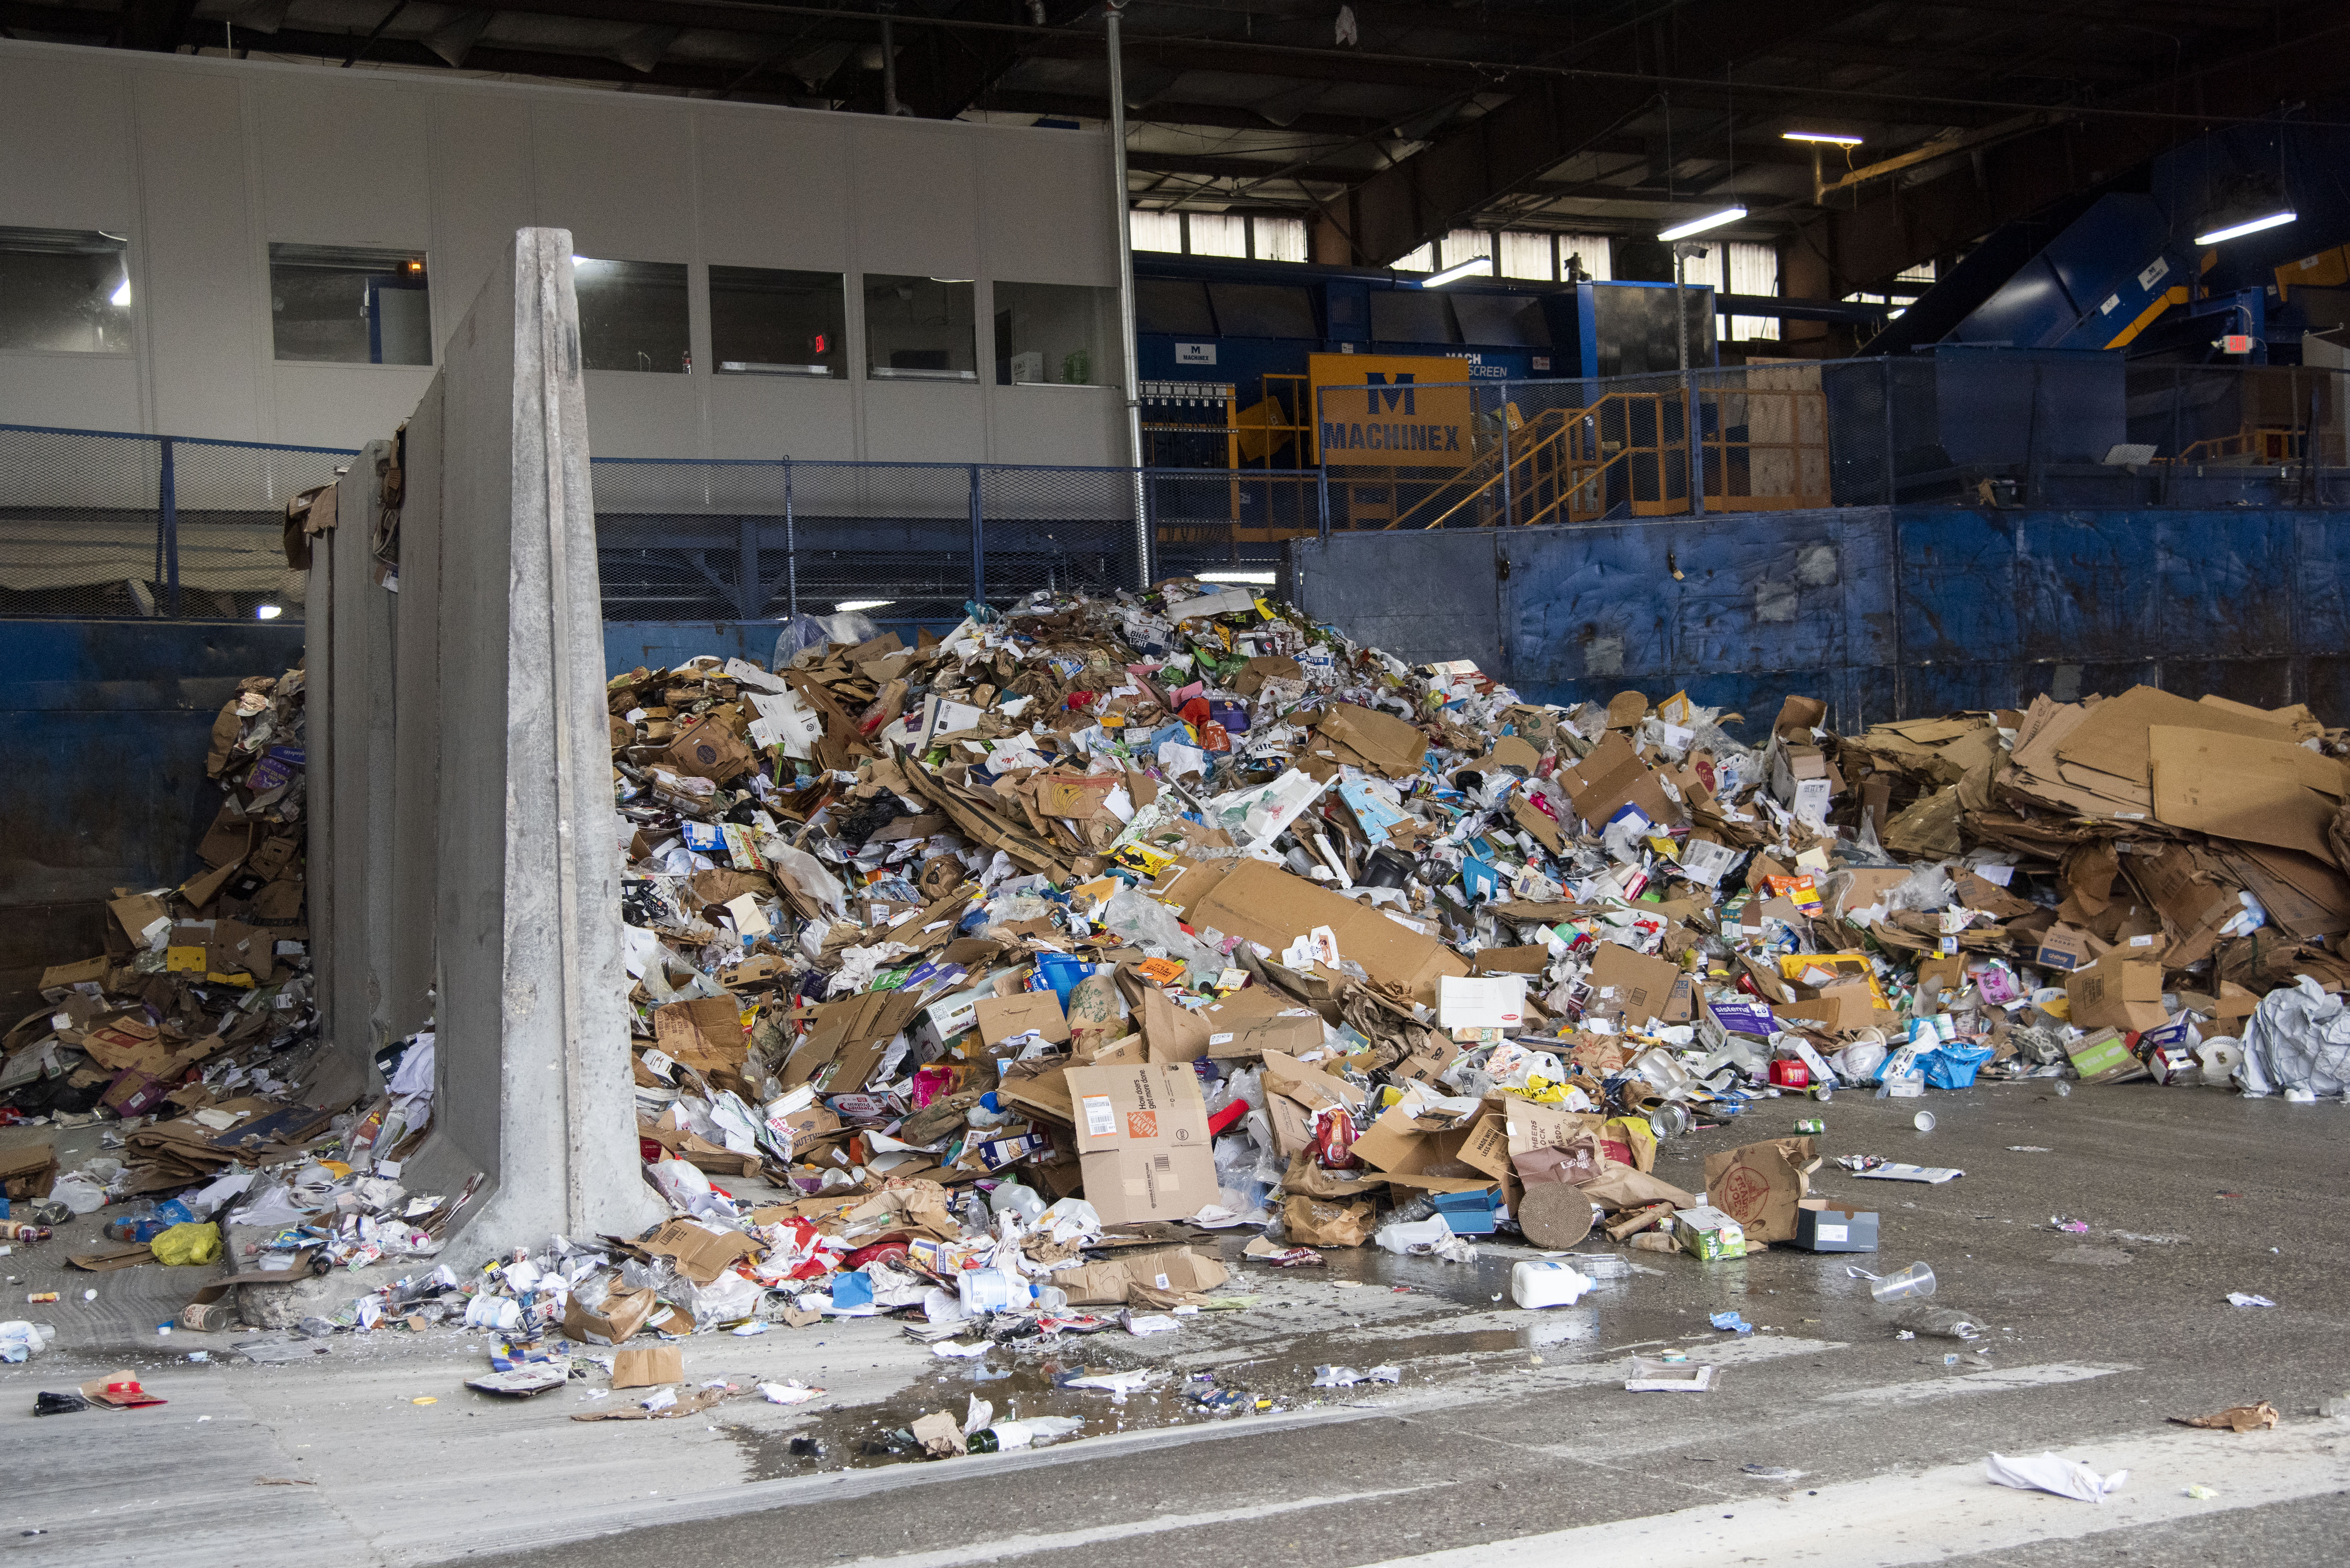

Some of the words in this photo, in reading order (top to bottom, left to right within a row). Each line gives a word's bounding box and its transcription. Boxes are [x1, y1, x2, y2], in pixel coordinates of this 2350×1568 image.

[2230, 336, 2246, 351] EXIT
[1323, 422, 1460, 451] MACHINEX
[1129, 638, 1148, 648] LIGHT
[1367, 803, 1394, 821] ALMOND
[741, 831, 765, 870] HUGGIES
[1145, 966, 1169, 978] MACHINE
[1029, 977, 1040, 993] lassic
[1715, 1006, 1749, 1014] sistema
[1141, 1069, 1149, 1084] done.
[1134, 1079, 1143, 1098] doers
[1128, 1111, 1157, 1137] HOME
[1132, 1125, 1144, 1135] THE
[1476, 1137, 1488, 1151] MADE
[1481, 1145, 1491, 1157] LESS
[1729, 1187, 1742, 1217] JOE'S
[1734, 1176, 1748, 1218] TRADER
[546, 1304, 553, 1315] 40
